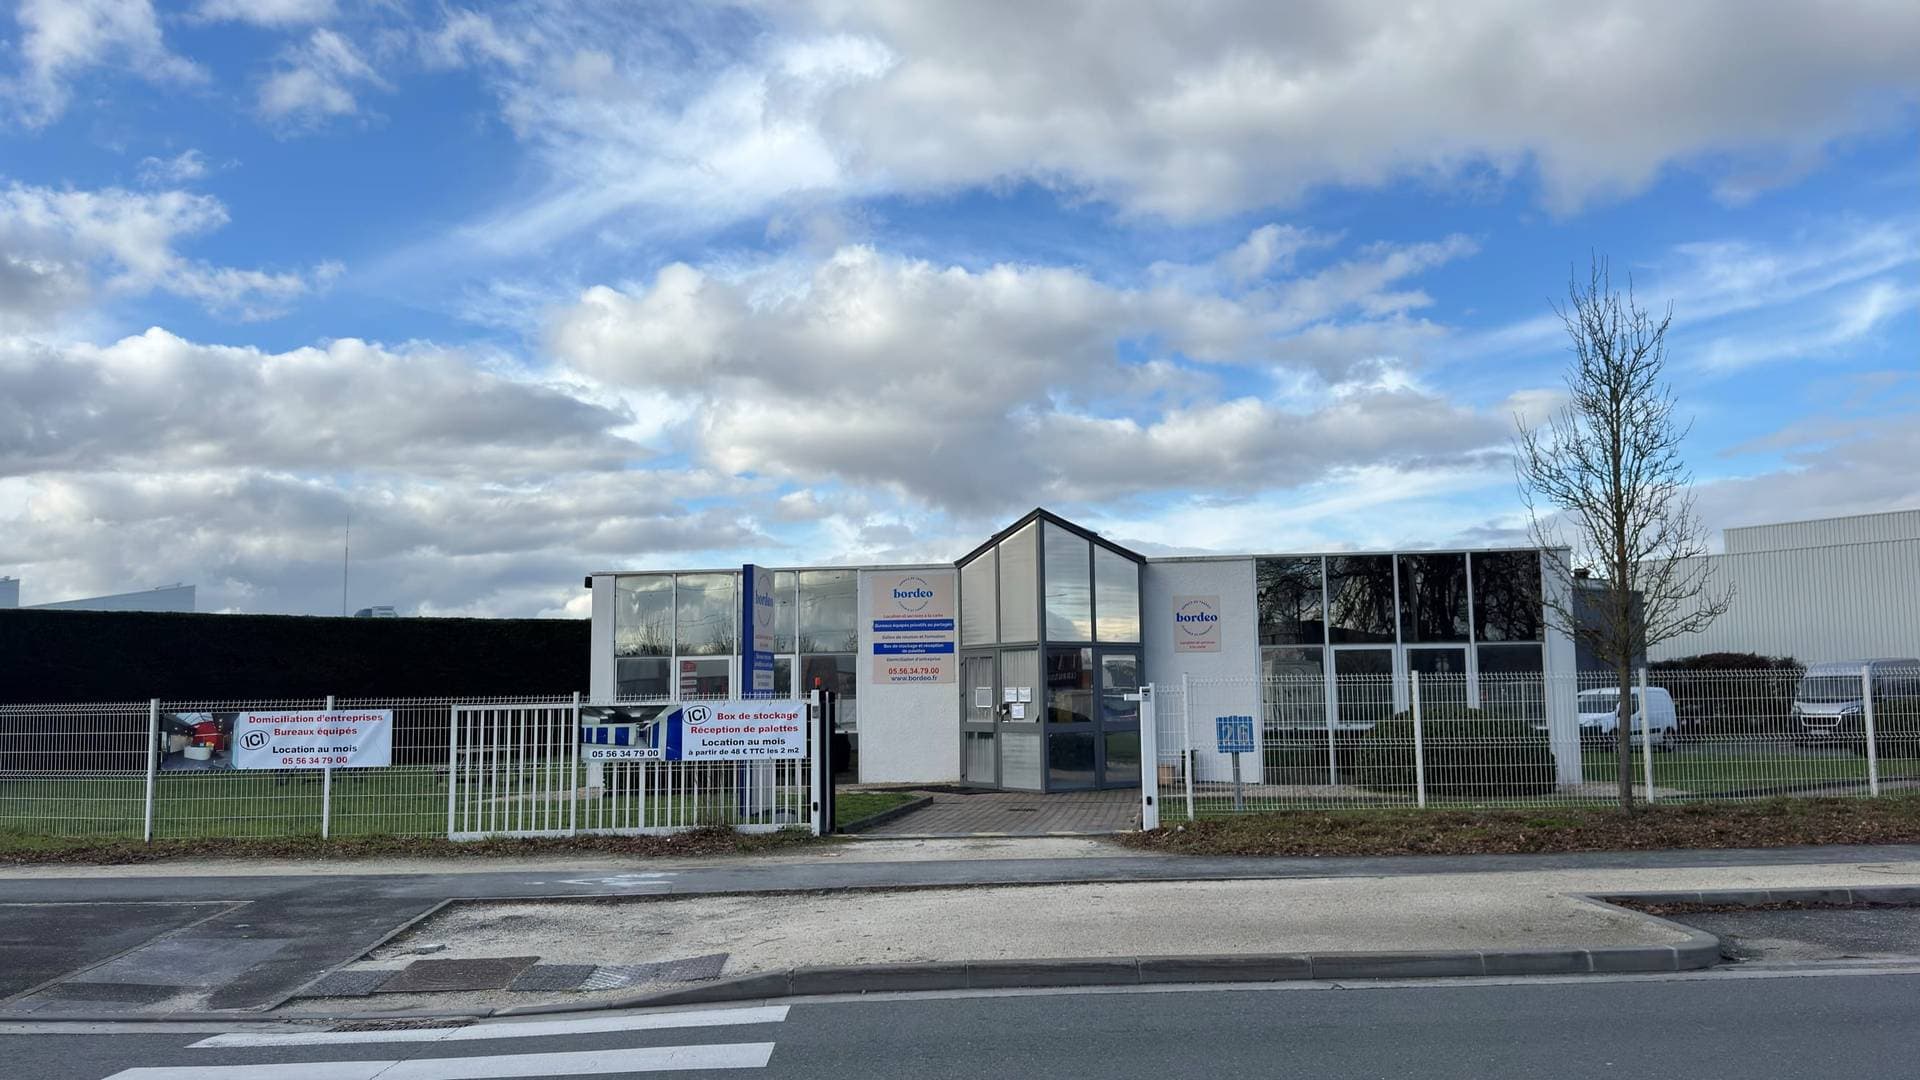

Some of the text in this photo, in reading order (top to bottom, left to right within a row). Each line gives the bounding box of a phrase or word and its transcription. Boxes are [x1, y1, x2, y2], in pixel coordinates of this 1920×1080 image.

[893, 588, 933, 599] bordeo
[1176, 611, 1218, 622] bordeo
[888, 667, 940, 675] 05.56.34.79.00
[248, 714, 384, 724] Domiciliation d'entreprises
[688, 708, 706, 723] ICI
[717, 711, 799, 722] Box de stockage
[273, 726, 358, 738] Bureaux équipés
[690, 724, 799, 735] Réception de palettes
[245, 732, 265, 748] ICI
[702, 738, 745, 747] Location
[762, 738, 786, 746] mois
[272, 744, 358, 754] Location au mois
[592, 749, 659, 758] 05 56 34 79 00
[695, 748, 715, 757] partir
[717, 748, 729, 756] de
[787, 747, 800, 755] m2
[282, 756, 348, 765] 05 56 34 79 00
